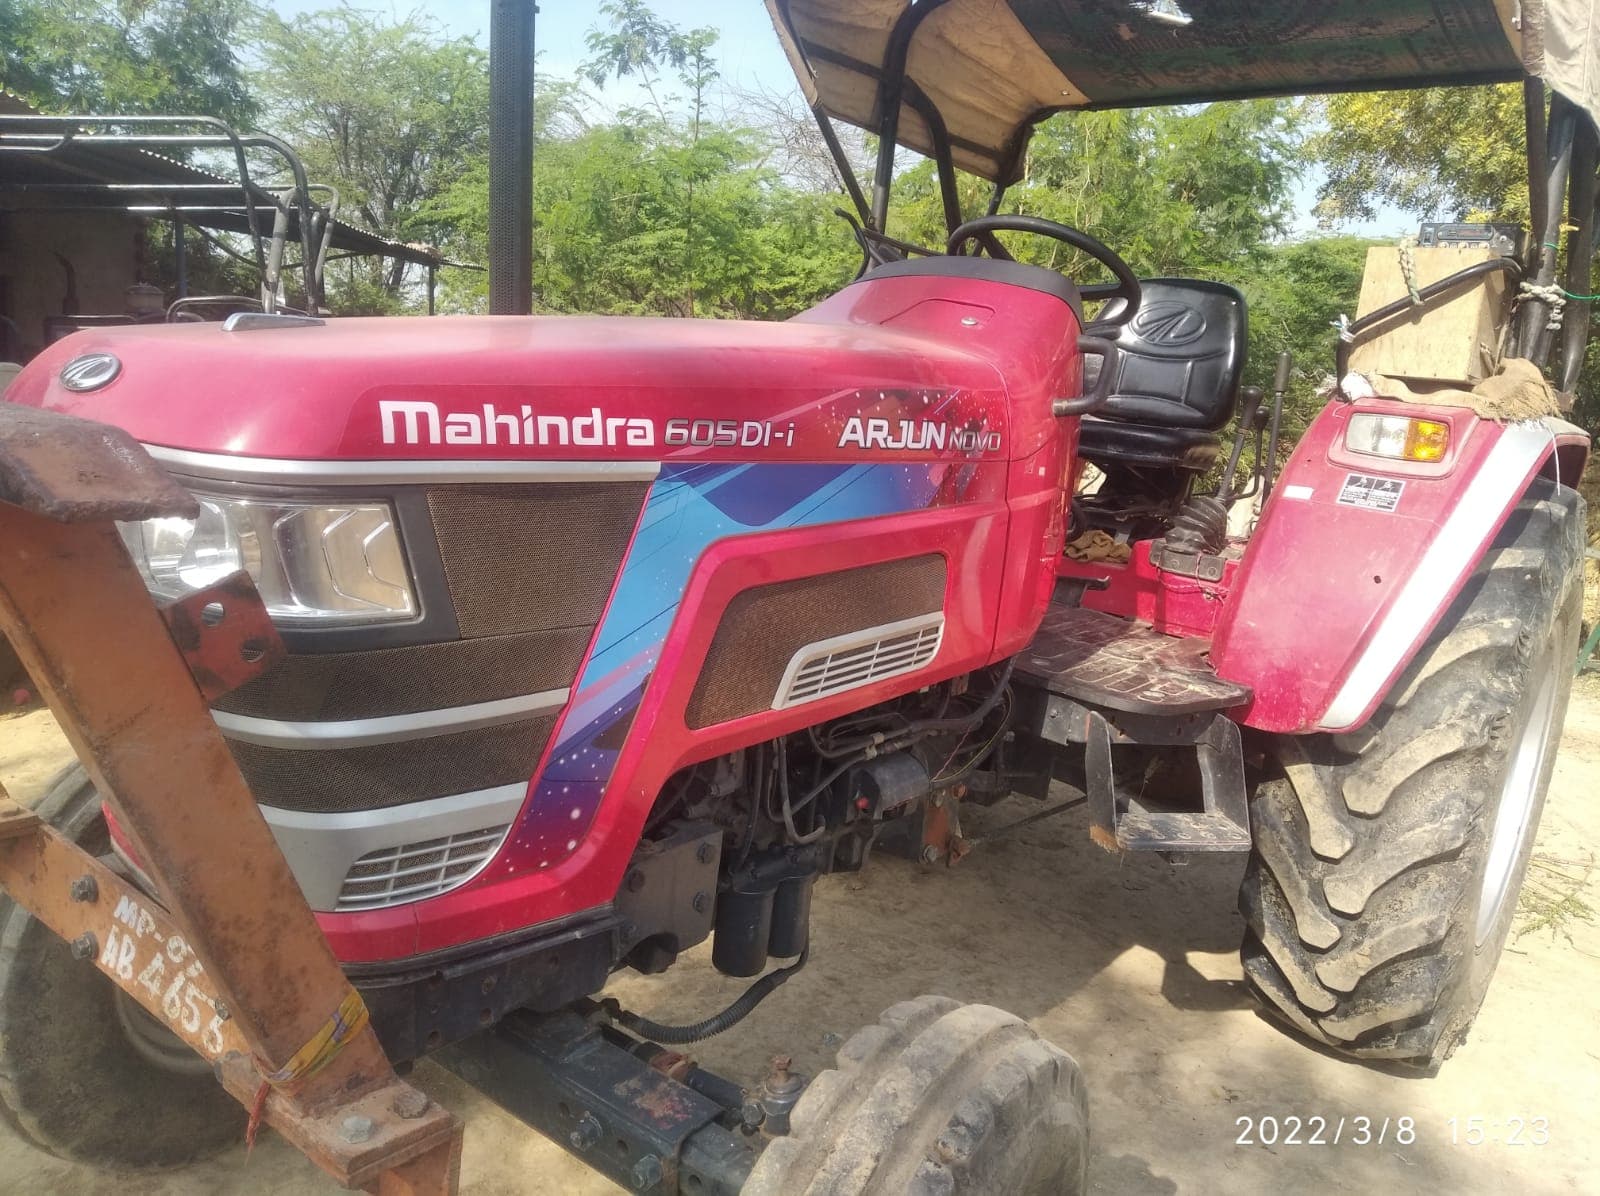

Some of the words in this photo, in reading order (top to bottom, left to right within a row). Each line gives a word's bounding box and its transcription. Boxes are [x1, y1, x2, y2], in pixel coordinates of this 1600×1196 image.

[379, 400, 655, 446] Mahindra
[837, 417, 947, 450] ARJUN
[949, 430, 1001, 451] NOVO
